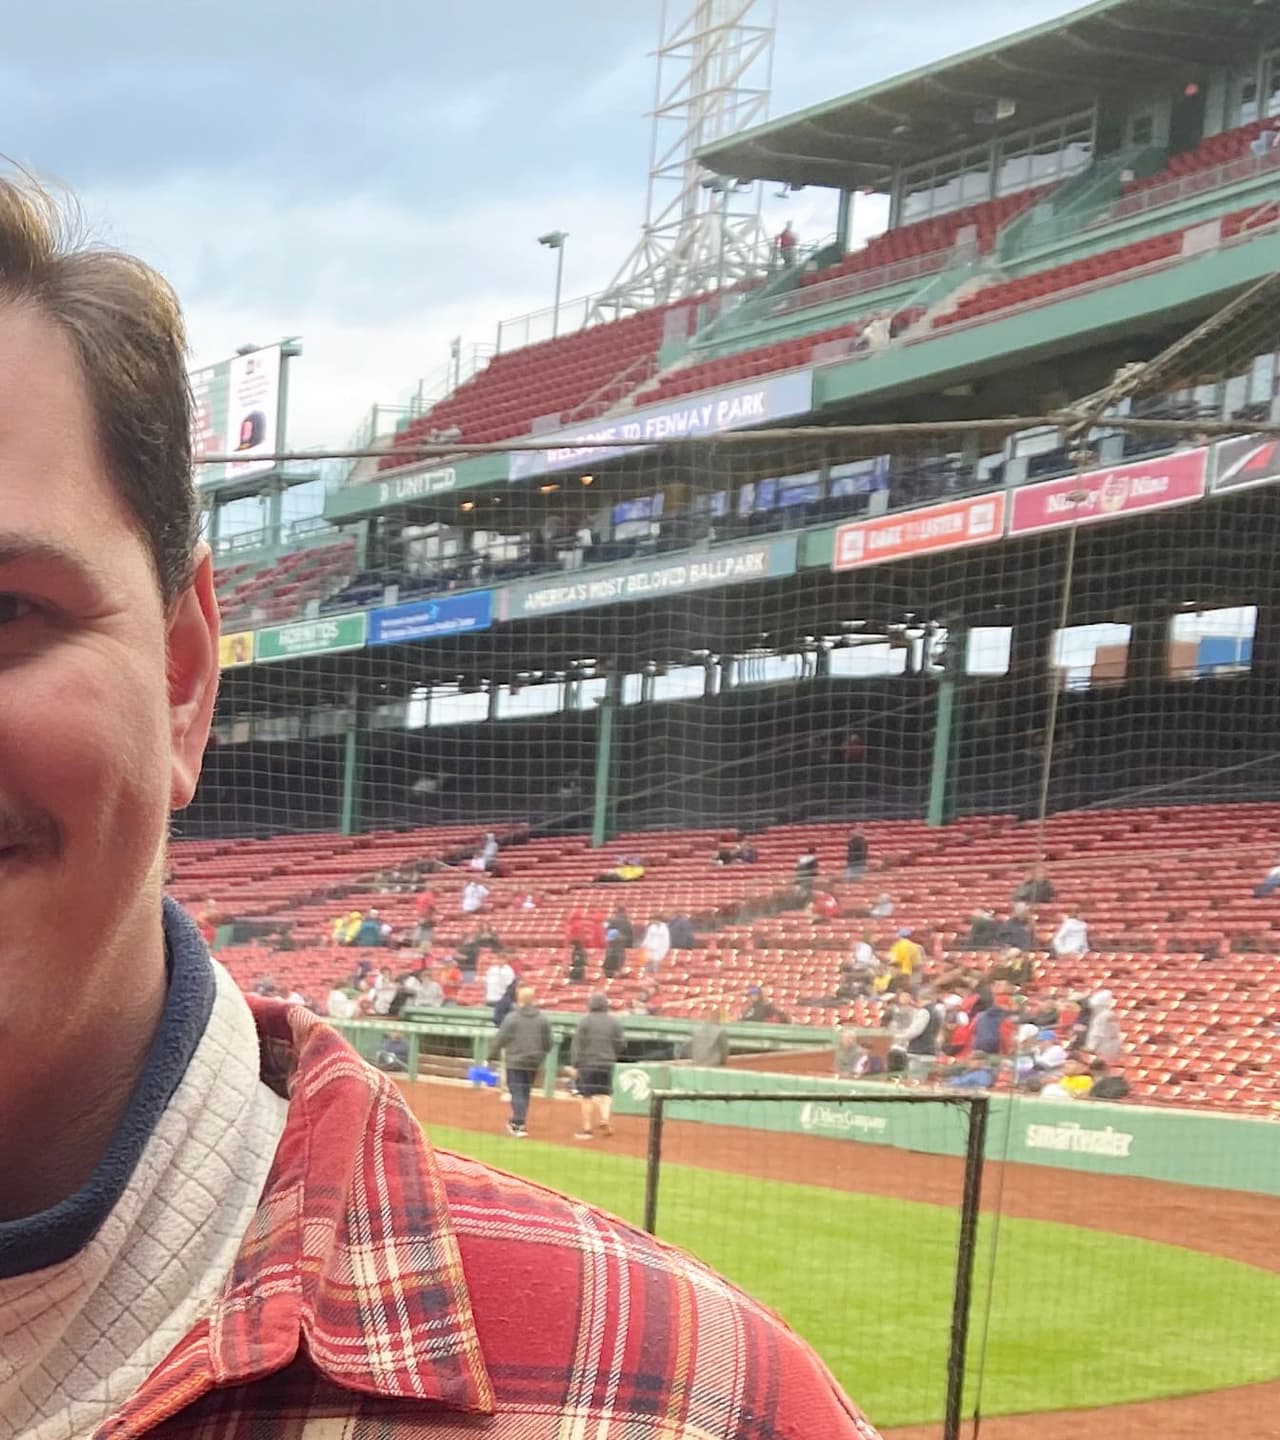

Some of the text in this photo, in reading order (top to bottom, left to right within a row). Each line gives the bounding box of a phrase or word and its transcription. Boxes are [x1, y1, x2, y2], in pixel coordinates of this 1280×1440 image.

[646, 404, 710, 438] FENWAY
[717, 392, 765, 424] PARK
[690, 552, 766, 580] BALLPARK
[1025, 1121, 1134, 1158] smartwater
